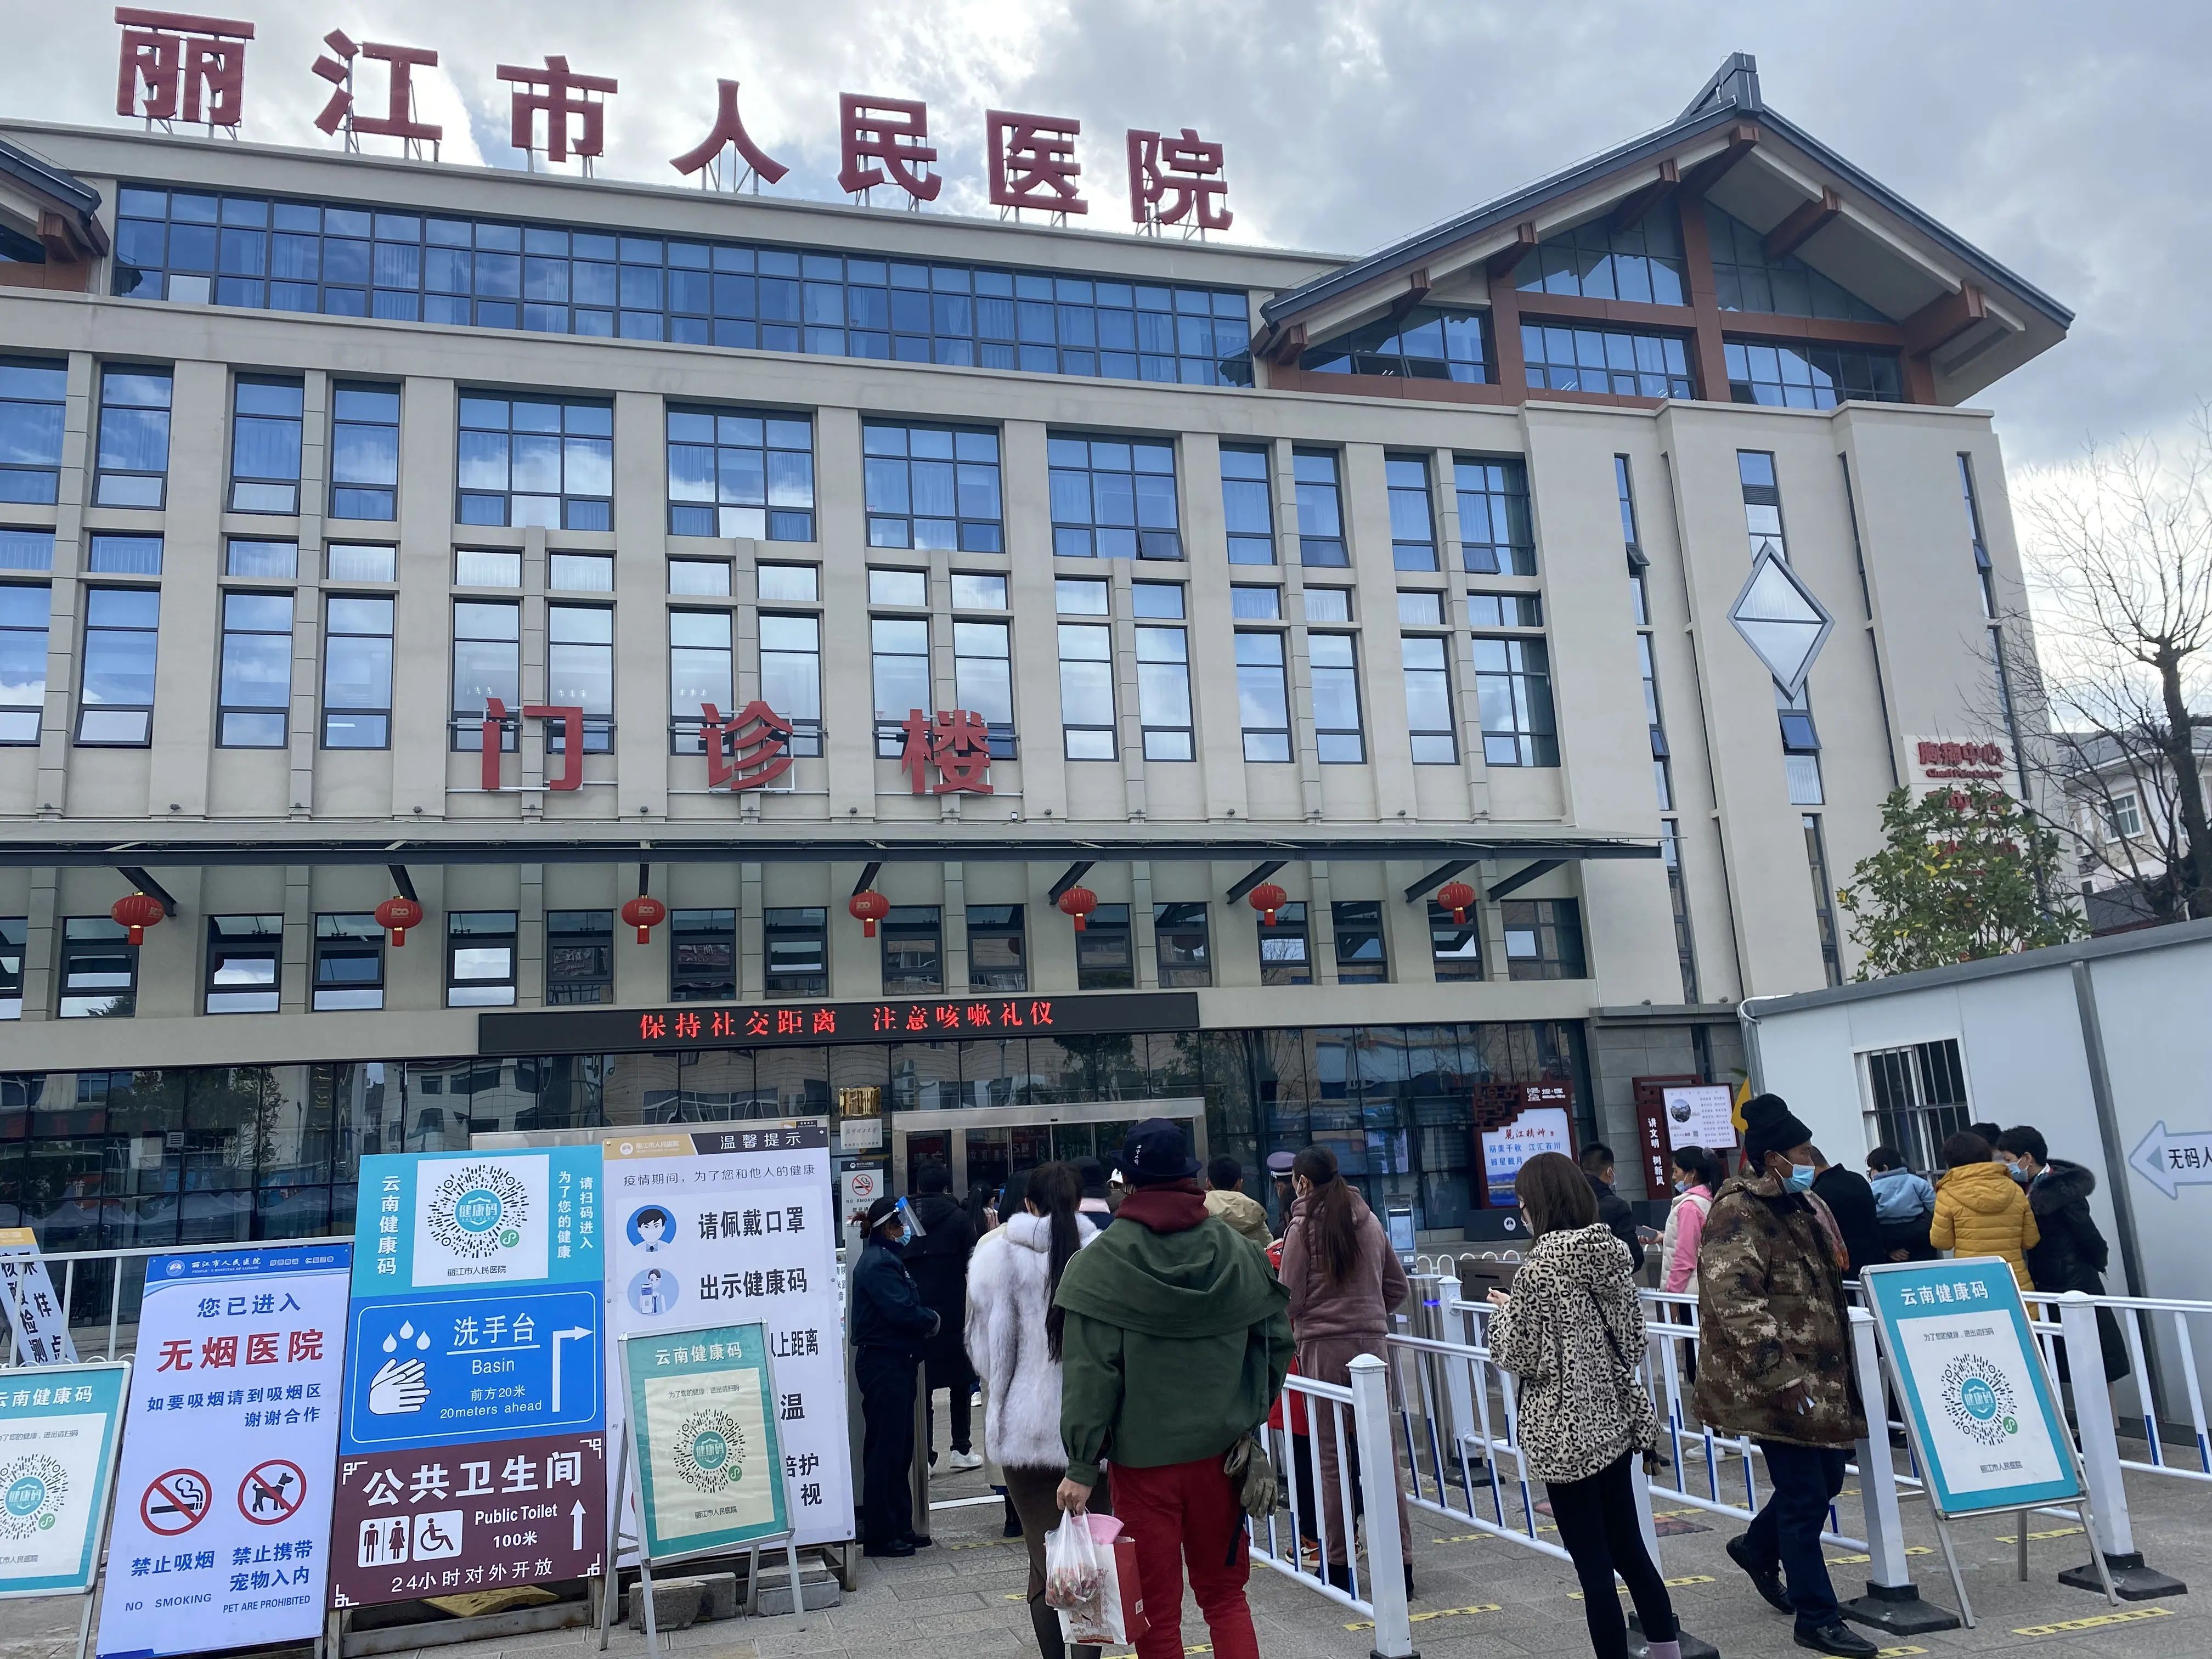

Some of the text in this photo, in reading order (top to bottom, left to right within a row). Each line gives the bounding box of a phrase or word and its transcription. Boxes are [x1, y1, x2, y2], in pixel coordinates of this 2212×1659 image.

[114, 7, 1233, 230] 丽江市人民医院
[482, 697, 994, 794] 门诊楼
[639, 1001, 1054, 1040] 保持社交距离 注意咳嗽礼仪
[720, 1131, 802, 1150] 温馨提示
[623, 1164, 815, 1187] 疫情期间，为了您和他人的健康
[459, 1203, 498, 1218] 健康码
[557, 1170, 572, 1259] 为了您的健康
[579, 1177, 594, 1250] 请扫码进入
[698, 1206, 805, 1240] 请佩戴口罩
[377, 1175, 402, 1276] 云南健康码
[191, 1257, 262, 1268] 丽江市人民医院
[447, 1265, 507, 1277] 丽江市人民医院
[699, 1267, 808, 1301] 出示健康码
[1900, 1280, 1989, 1307] 云南健康码
[198, 1293, 301, 1318] 您已进入
[453, 1312, 535, 1347] 洗手台
[156, 1328, 324, 1373] 无烟医院
[654, 1341, 743, 1367] 云南健康码
[472, 1357, 515, 1375] Basin
[147, 1383, 321, 1413] 如要吸烟请到吸烟区
[470, 1385, 526, 1402] 前方20米
[245, 1407, 321, 1427] 谢谢合作
[440, 1400, 542, 1419] 20meters ahead
[696, 1442, 725, 1458] 健康码
[362, 1451, 582, 1506] 公共卫生间
[8, 1489, 42, 1503] 健康码
[475, 1503, 558, 1526] Public Toilet
[695, 1505, 738, 1519] 丽江市人民医院
[232, 1539, 313, 1566] 禁止携带
[493, 1530, 538, 1549] 100米
[131, 1550, 215, 1577] 禁止吸烟
[391, 1558, 553, 1593] 24小时对外开放
[229, 1566, 309, 1592] 宠物入内
[125, 1593, 212, 1611] NO SMOKING
[223, 1595, 311, 1613] PET ARE PROHIBITED
